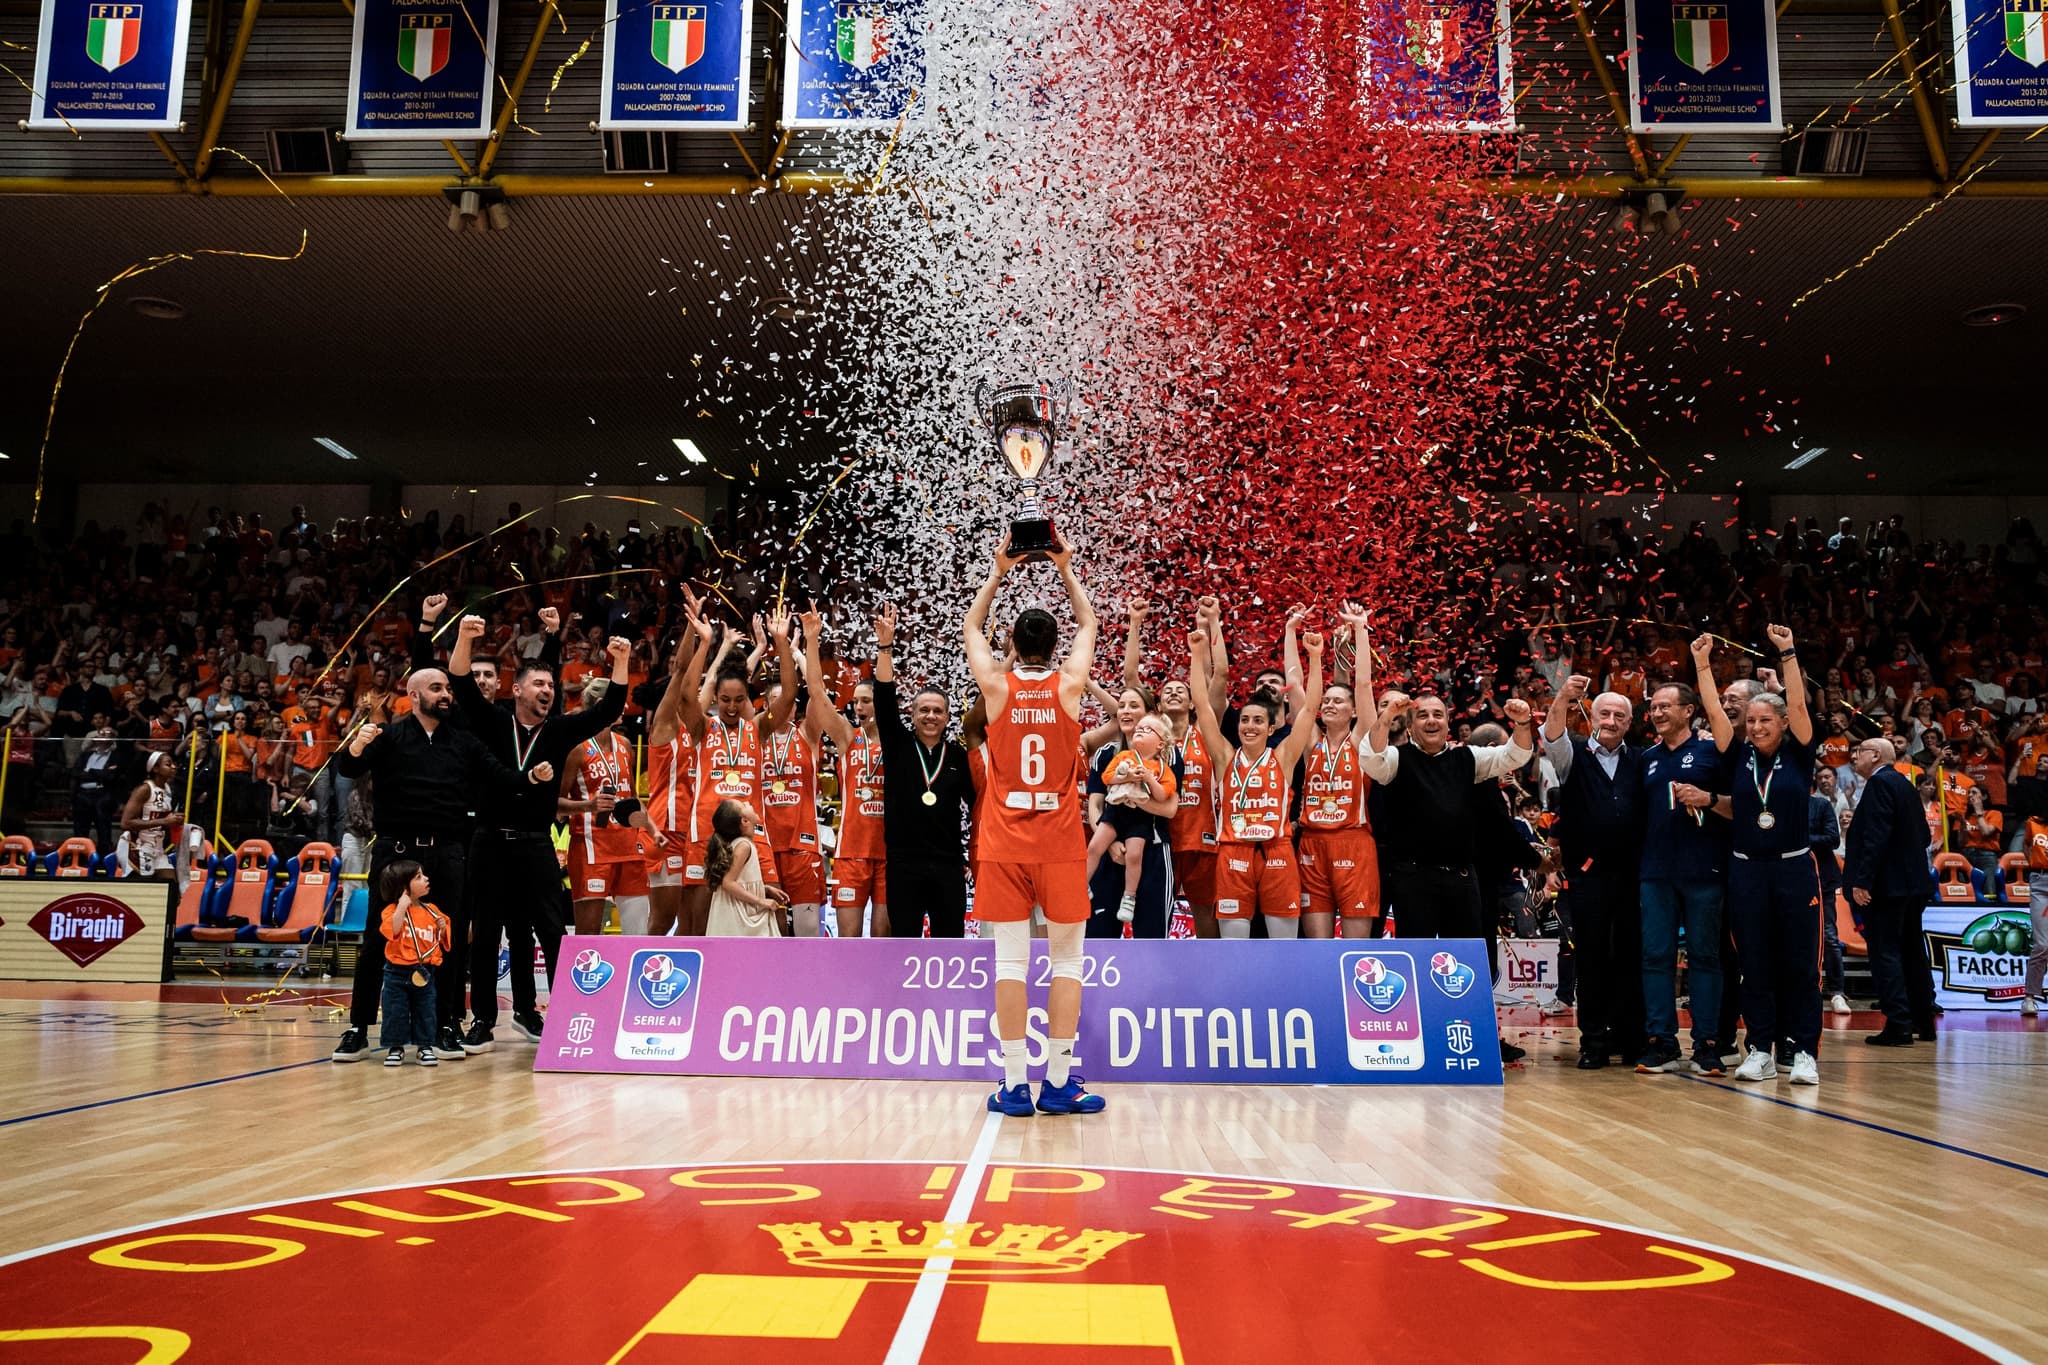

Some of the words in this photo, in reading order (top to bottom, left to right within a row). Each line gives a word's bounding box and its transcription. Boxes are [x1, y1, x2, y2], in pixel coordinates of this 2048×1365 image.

[98, 6, 134, 18] FIP
[662, 7, 697, 19] FIP
[1682, 6, 1718, 18] FIP
[408, 16, 444, 28] FIP
[50, 81, 78, 89] SQUADRA
[79, 82, 109, 90] CAMPIONE
[111, 82, 134, 90] D'ITALIA
[135, 82, 166, 90] FEMMINILE
[616, 83, 645, 91] SQUADRA
[646, 83, 677, 91] CAMPIONE
[679, 83, 702, 91] D'ITALIA
[703, 83, 735, 92] FEMMINILE
[1644, 84, 1673, 92] SQUADRA
[1674, 84, 1705, 92] CAMPIONE
[1707, 84, 1731, 92] D'ITALIA
[1732, 84, 1765, 92] FEMMINILE
[1974, 78, 2004, 86] SQUADRA
[2005, 78, 2039, 86] CAMPIONE
[91, 92, 123, 100] 2014-2015
[363, 92, 390, 100] SQUADRA
[447, 91, 479, 99] FEMMINILE
[659, 93, 692, 102] 2007-2008
[2021, 88, 2048, 96] 2013-20
[1688, 95, 1721, 103] 2012-2013
[1985, 99, 2036, 107] PALLACANESTRO
[57, 102, 104, 110] PALLACANESTRO
[105, 102, 135, 110] FEMMINILE
[136, 103, 156, 111] SCHIO
[404, 102, 435, 110] 2010-2011
[624, 103, 672, 111] PALLACANESTRO
[705, 103, 726, 112] SCHIO
[1653, 104, 1703, 113] PALLACANESTRO
[1703, 104, 1736, 113] FEMMINILE
[1737, 104, 1758, 113] SCHIO
[364, 111, 376, 120] ASD
[377, 111, 424, 120] PALLACANESTRO
[455, 111, 475, 120] SCHIO
[1011, 708, 1057, 724] SOTTANA
[706, 732, 722, 749] 25
[850, 750, 867, 766] 24
[1021, 733, 1046, 786] 6
[1309, 754, 1319, 772] 7
[588, 760, 607, 779] 33
[1184, 760, 1203, 775] ila
[863, 801, 885, 813] Wüb
[75, 906, 100, 914] 1934
[50, 912, 125, 943] Biraghi
[902, 956, 988, 989] 2025
[1508, 959, 1548, 983] LBF
[581, 972, 603, 983] LBF
[1443, 975, 1465, 987] LBF
[651, 982, 678, 995] LBF
[1369, 985, 1394, 999] LBF
[633, 1015, 665, 1026] SERIE
[668, 1015, 682, 1027] A1
[1359, 1021, 1392, 1032] SERIE
[1395, 1021, 1408, 1032] A1
[1109, 1007, 1316, 1069] D'ITALIA
[558, 1047, 593, 1058] FIP
[630, 1046, 675, 1057] Techfind
[1364, 1055, 1410, 1065] Techfind
[1445, 1058, 1480, 1071] FIP
[919, 1166, 1105, 1203] di
[88, 1167, 822, 1273] Schio
